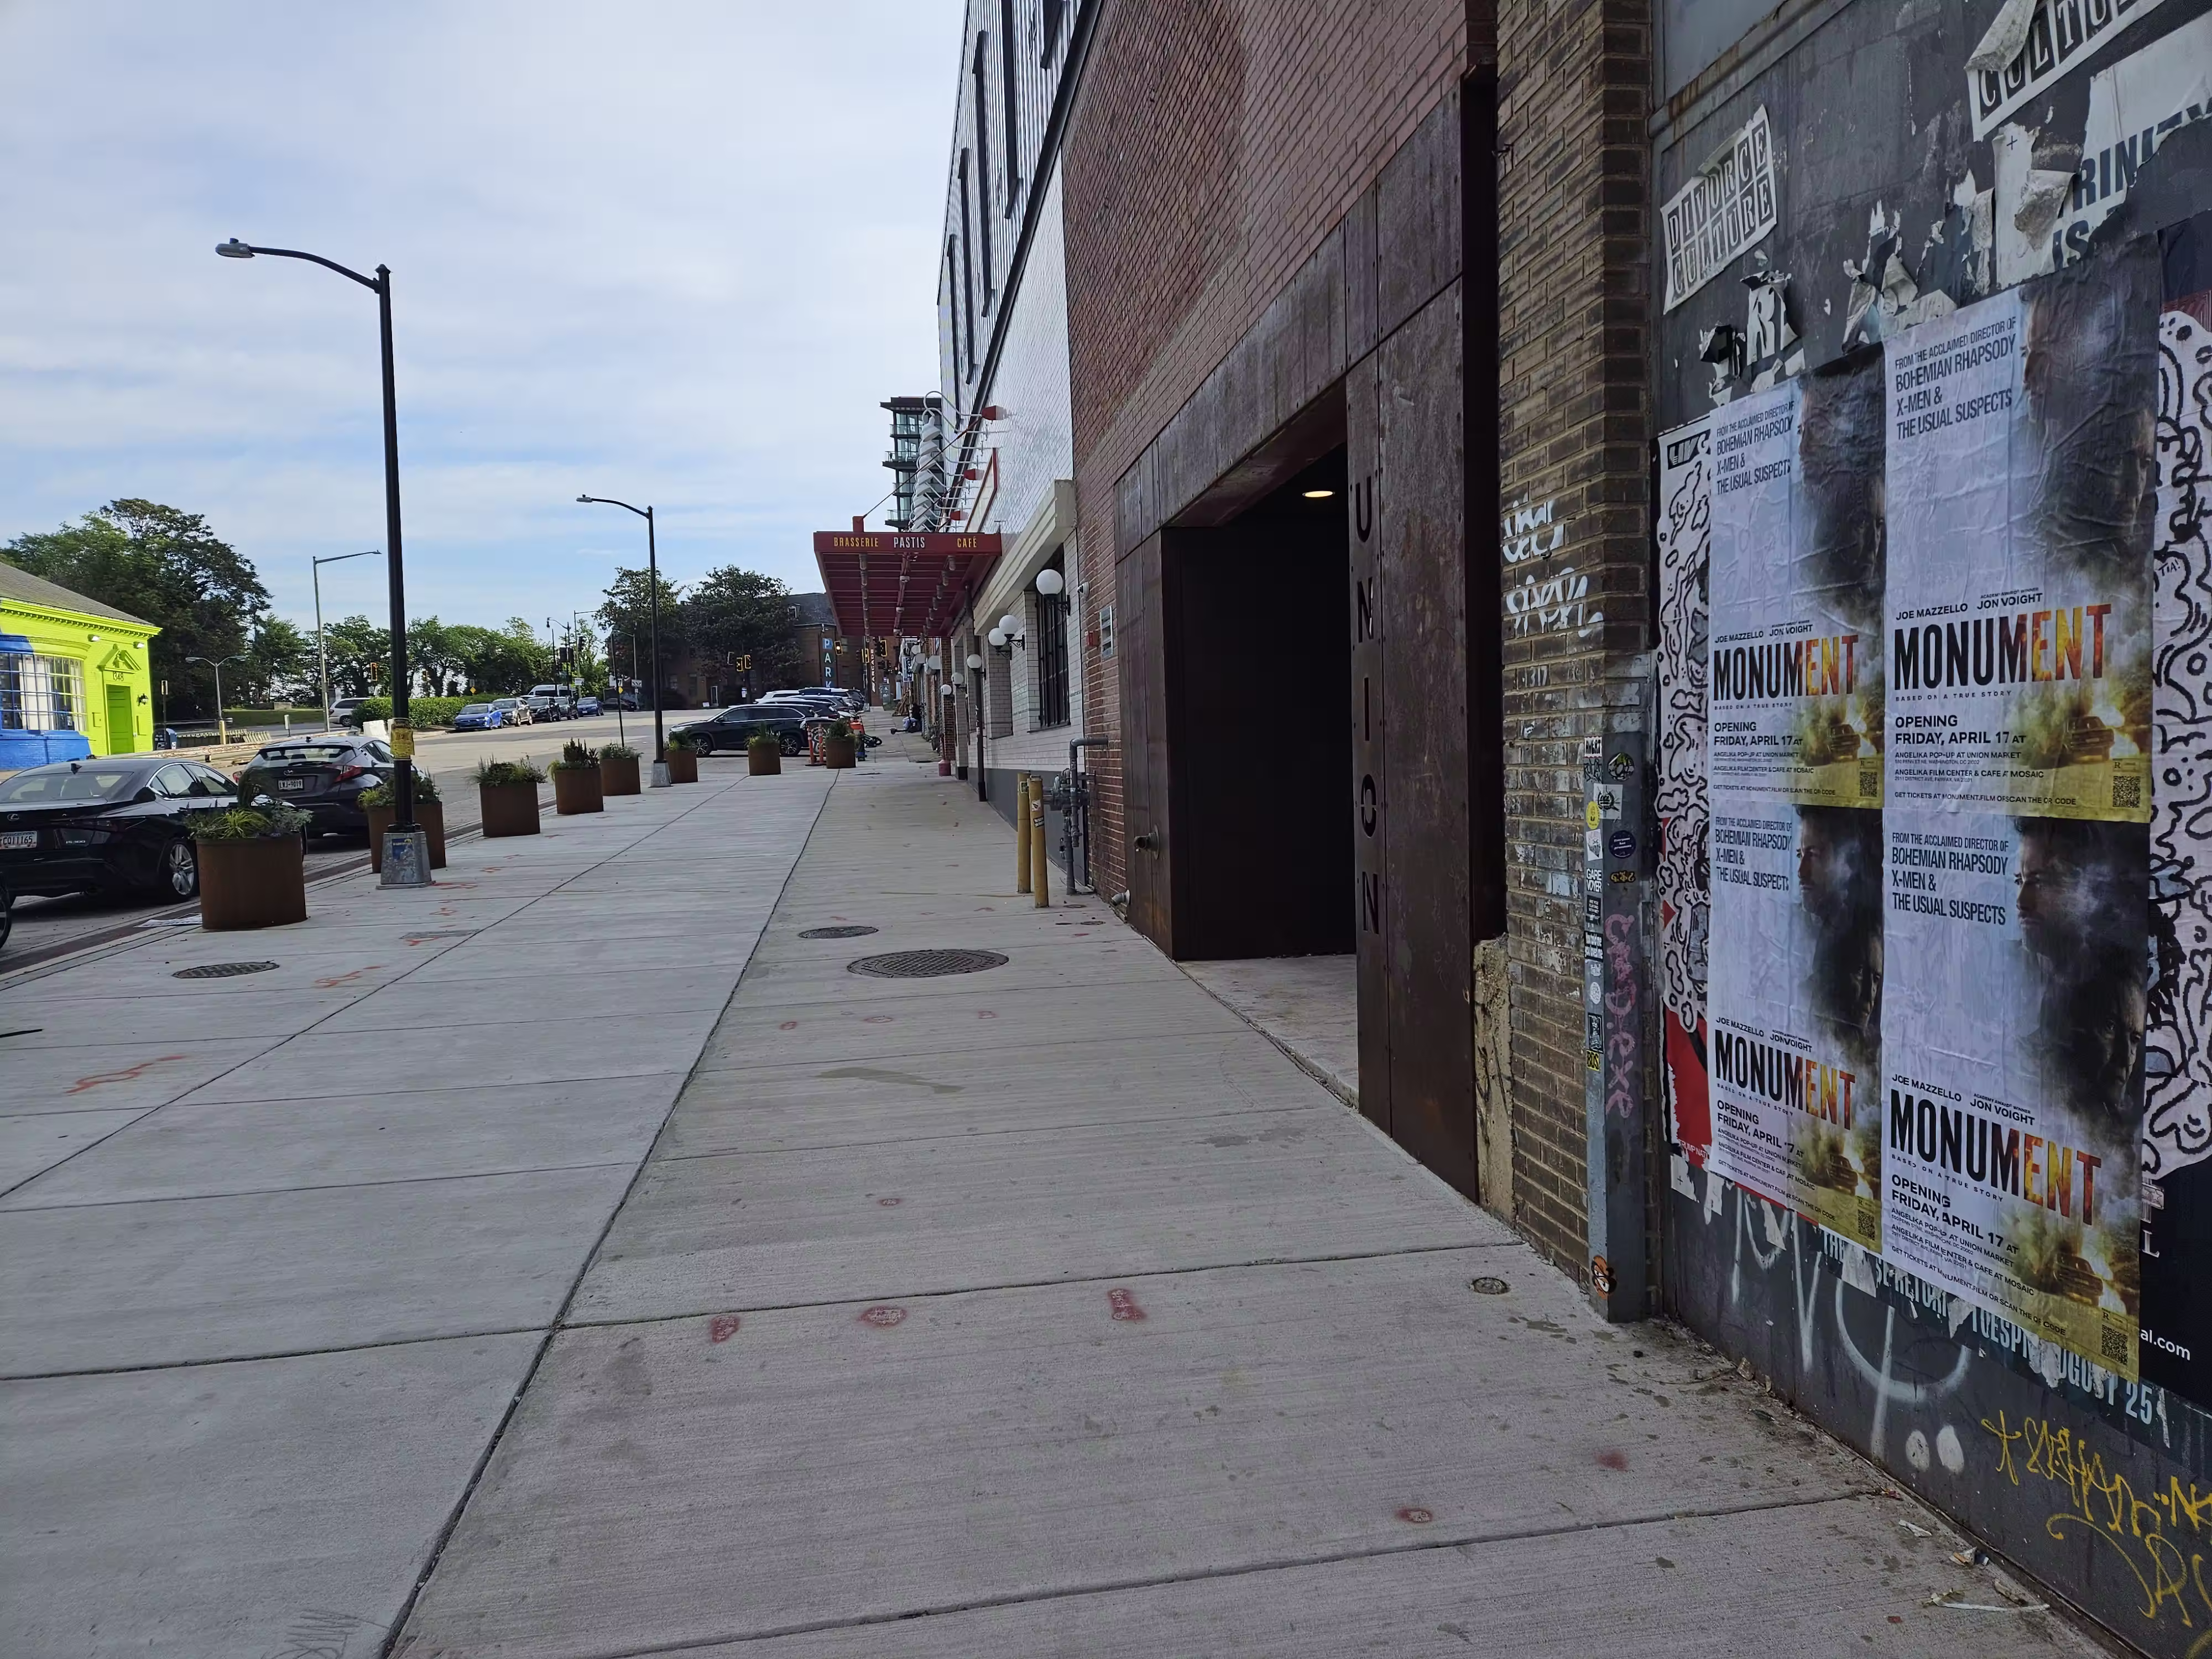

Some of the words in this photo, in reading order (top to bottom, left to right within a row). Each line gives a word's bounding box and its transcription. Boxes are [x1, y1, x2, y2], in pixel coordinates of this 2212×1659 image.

[1980, 0, 2130, 107] CULTU
[1669, 126, 1766, 250] DIVORCE
[1673, 179, 1770, 294] CULTURE
[1895, 353, 1913, 371] FROM
[1914, 348, 1927, 364] THE
[1929, 334, 1968, 359] ACCLAIMED
[1970, 321, 2005, 345] DIRECTOR
[2006, 317, 2016, 332] OF
[1896, 355, 1952, 393] BOHEMIAN
[1955, 333, 2016, 373] RHAPSODY
[1896, 389, 1931, 417] X-MEN
[1933, 387, 1942, 407] &
[1896, 417, 1916, 440] THE
[1918, 406, 1953, 434] USUAL
[1955, 388, 2012, 423] SUSPECTS
[1717, 429, 1752, 456] BOHEMIAN
[1716, 454, 1739, 476] X-MEN
[1740, 452, 1745, 469] &
[1716, 477, 1729, 495] THE
[1730, 470, 1752, 492] USUAL
[834, 537, 879, 547] BRASSERIE
[894, 537, 925, 548] PASTIS
[957, 536, 977, 547] CAFÉ
[1896, 609, 1914, 620] JOE
[1917, 603, 1968, 618] MAZZELLO
[1976, 598, 1999, 611] JON
[2000, 593, 2043, 607] VOIGHT
[1714, 635, 1728, 644] JOE
[1729, 631, 1764, 642] MAZZELLO
[1769, 628, 1783, 637] JON
[1785, 624, 1813, 635] VOIGHT
[1894, 604, 2112, 691] MONUMENT
[1714, 635, 1859, 701] MONUMENT
[1355, 476, 1379, 935] UNION
[1895, 715, 1958, 728] OPENING
[1714, 722, 1757, 732] OPENING
[1714, 737, 1748, 747] FRIDAY,
[1750, 737, 1779, 745] APRIL
[1781, 737, 1792, 745] 17
[1895, 732, 1944, 747] FRIDAY,
[1948, 732, 1991, 744] APRIL
[1995, 731, 2010, 744] 17
[2011, 734, 2026, 744] AT
[1714, 829, 1750, 847] BOHEMIAN
[1752, 832, 1792, 851] RHAPSODY
[1762, 820, 1785, 831] DIRECTOR
[1892, 832, 1909, 844] FROM
[1911, 834, 1922, 845] THE
[1923, 834, 1962, 848] ACCLAIMED
[1964, 838, 1998, 851] DIRECTOR
[2000, 840, 2008, 852] OF
[1715, 847, 1738, 864] X-MEN
[1739, 850, 1745, 865] &
[1892, 847, 1945, 869] BOHEMIAN
[1948, 852, 2008, 875] RHAPSODY
[1586, 868, 1602, 881] GARE
[1716, 866, 1729, 883] THE
[1729, 868, 1751, 886] USUAL
[1891, 869, 1926, 890] X-MEN
[1928, 873, 1936, 891] &
[1892, 892, 1911, 912] THE
[1913, 895, 1947, 917] USUAL
[1949, 899, 2005, 925] SUSPECTS
[1715, 1015, 1730, 1026] JOE
[1730, 1020, 1764, 1037] MAZZELLO
[1783, 1037, 1812, 1053] VOIGHT
[1715, 1029, 1856, 1130] MONUMENT
[1717, 1100, 1760, 1125] OPENING
[1891, 1073, 1909, 1086] JOE
[1911, 1079, 1961, 1102] MAZZELLO
[1969, 1097, 1991, 1112] JON
[1994, 1104, 2035, 1126] VOIGHT
[1718, 1113, 1750, 1136] FRIDAY,
[1752, 1128, 1782, 1149] APRIL
[1796, 1149, 1804, 1159] AT
[1891, 1089, 2101, 1225] MONUMENT
[1891, 1173, 1951, 1208] OPENING
[1922, 1166, 1933, 1175] ON
[1944, 1175, 1968, 1188] TRUE
[1973, 1186, 2003, 1202] STORY
[1891, 1188, 1939, 1222] FRIDAY,
[1942, 1211, 1984, 1240] APRIL
[1987, 1230, 2004, 1249] 17
[2006, 1242, 2018, 1255] AT
[1891, 1207, 1923, 1227] ANGELIKA
[1949, 1233, 1958, 1243] AT
[1959, 1237, 1982, 1254] UNION
[1984, 1248, 2014, 1268] MARKET
[1891, 1223, 1923, 1243] ANGELIKA
[1924, 1238, 1939, 1251] FILM
[1974, 1262, 1993, 1277] CAFE
[1994, 1271, 2004, 1281] AT
[2005, 1276, 2034, 1296] MOSAIC
[1891, 1245, 1903, 1256] GET
[1903, 1250, 1928, 1269] TICKETS
[1929, 1263, 1937, 1272] AT
[1989, 1292, 1999, 1303] OR
[1999, 1297, 2017, 1312] SCAN
[2018, 1307, 2032, 1320] THE
[2042, 1318, 2066, 1336] CODE
[2125, 1379, 2153, 1425] 25
